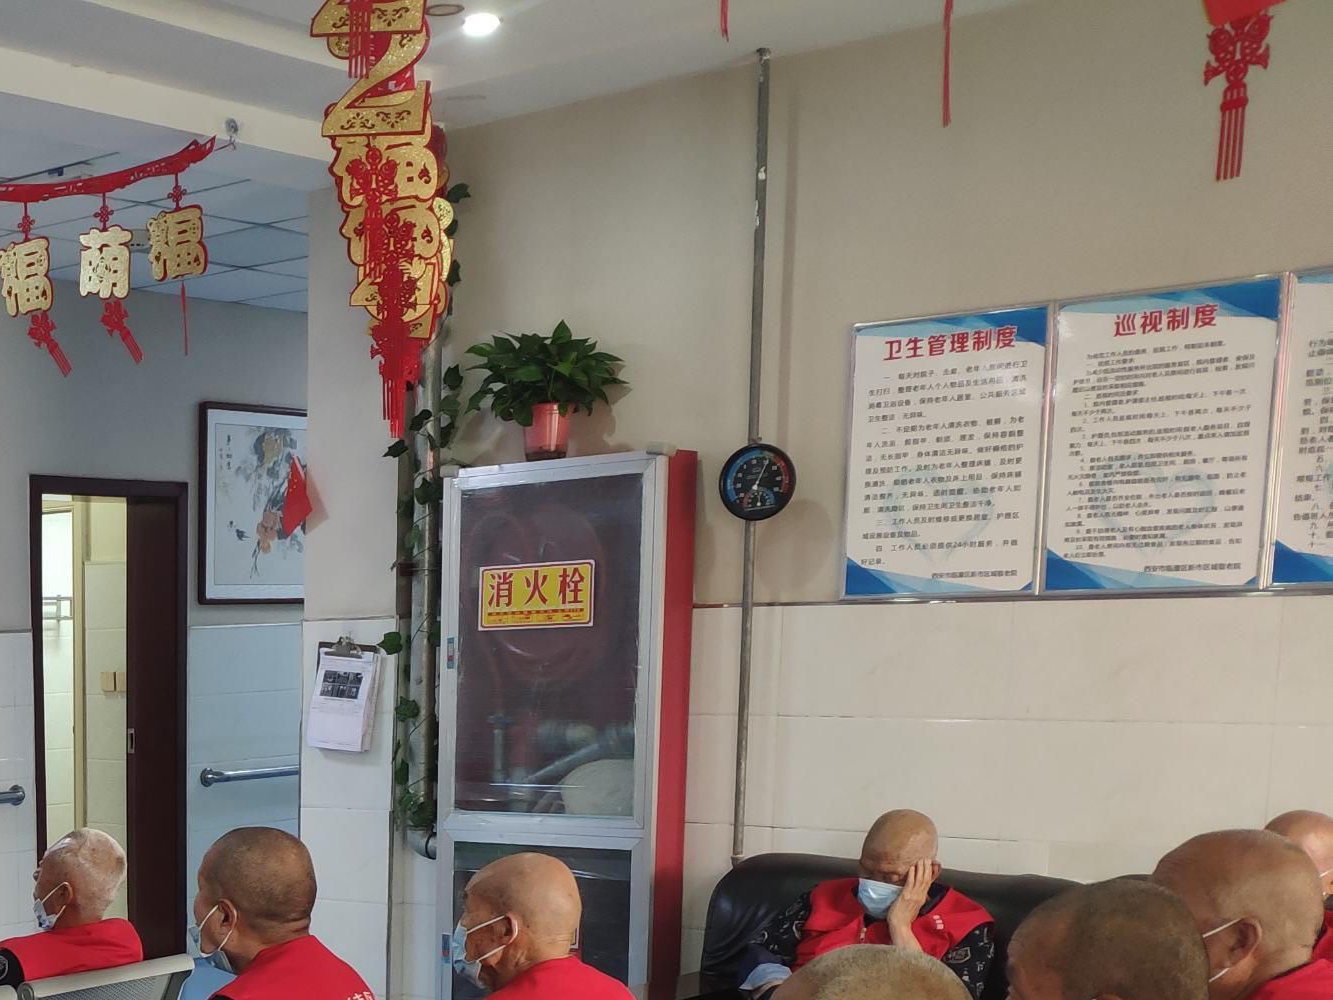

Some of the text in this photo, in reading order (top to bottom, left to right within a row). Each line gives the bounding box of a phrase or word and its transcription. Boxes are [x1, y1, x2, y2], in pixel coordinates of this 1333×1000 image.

[1114, 304, 1218, 337] 巡视制度
[883, 325, 1018, 361] 卫生管理制度
[488, 567, 585, 607] 消火栓
